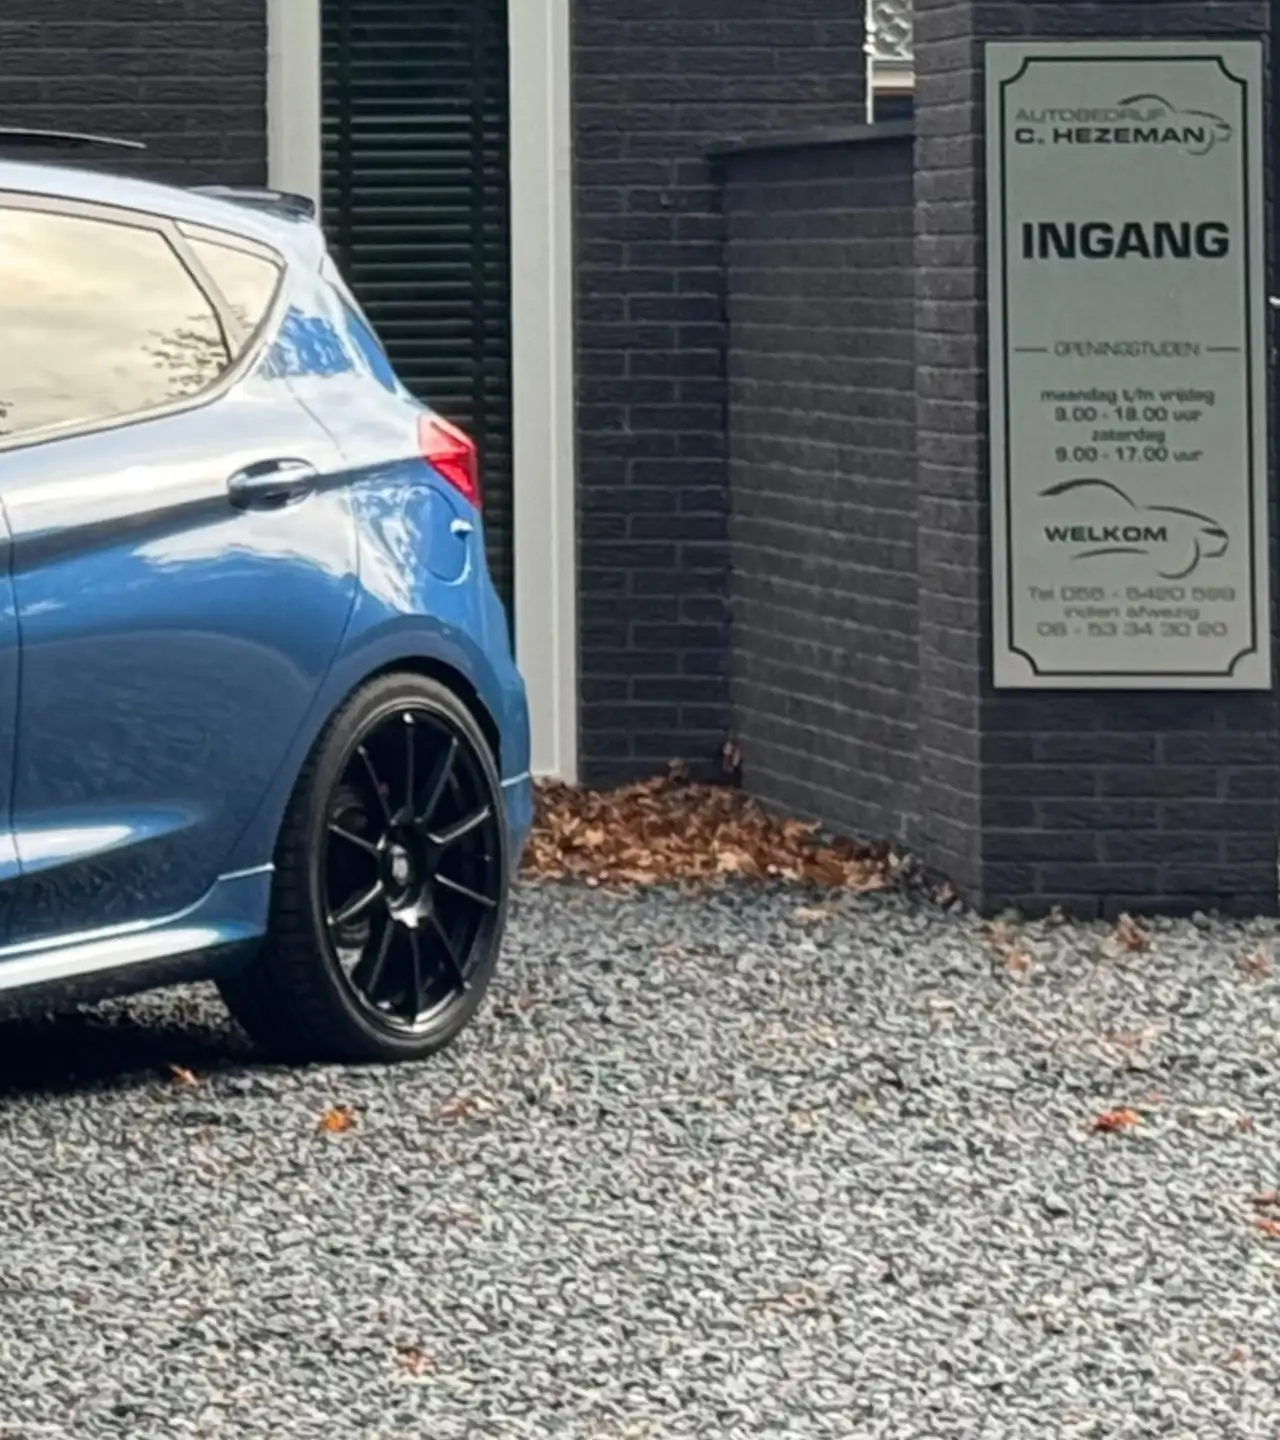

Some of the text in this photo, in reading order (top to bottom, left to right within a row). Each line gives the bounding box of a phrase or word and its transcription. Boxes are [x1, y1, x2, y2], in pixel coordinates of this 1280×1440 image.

[1014, 127, 1205, 144] C. HEZEMAN
[1021, 221, 1230, 260] INGANG
[1173, 409, 1203, 421] uur
[1173, 450, 1204, 462] uur
[1044, 526, 1168, 542] WELKOM
